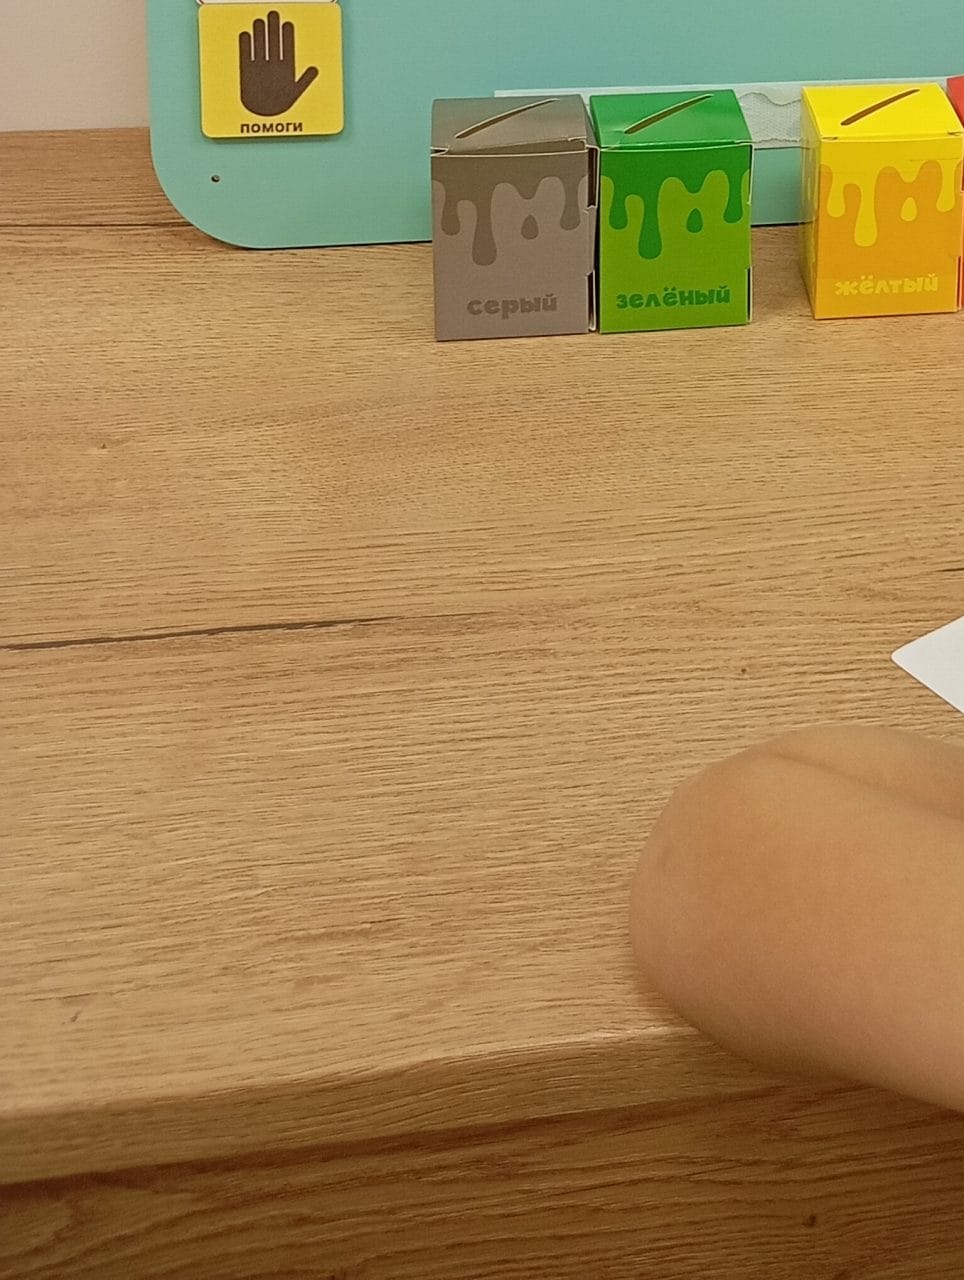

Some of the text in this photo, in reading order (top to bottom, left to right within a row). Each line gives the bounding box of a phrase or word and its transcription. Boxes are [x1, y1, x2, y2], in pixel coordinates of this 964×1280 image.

[833, 272, 939, 297] жёлтый
[466, 293, 558, 320] серый
[615, 285, 731, 310] зелёный
